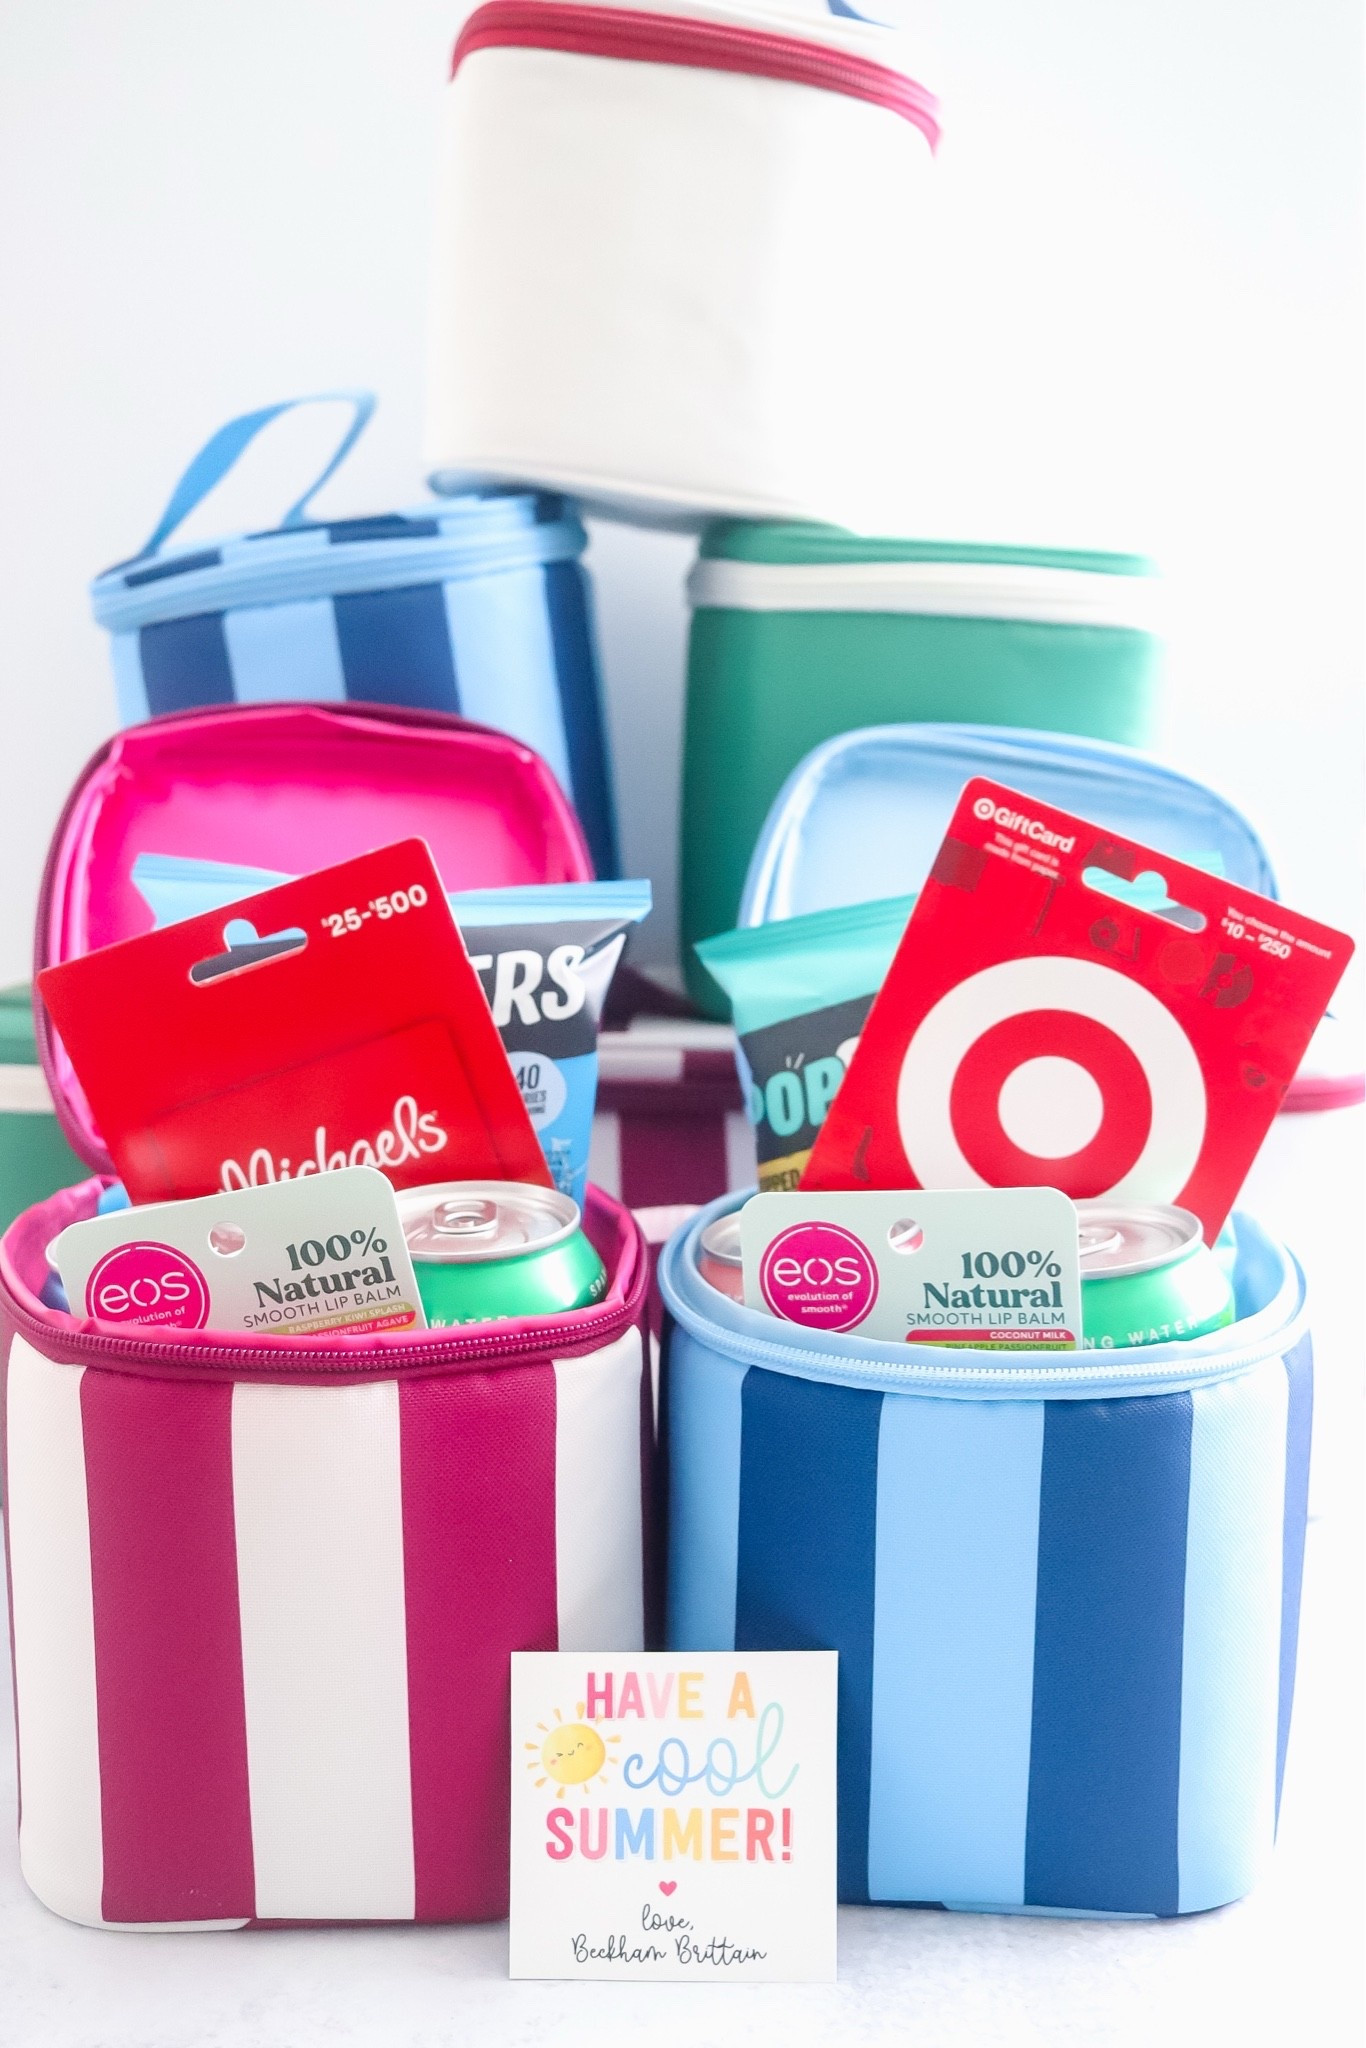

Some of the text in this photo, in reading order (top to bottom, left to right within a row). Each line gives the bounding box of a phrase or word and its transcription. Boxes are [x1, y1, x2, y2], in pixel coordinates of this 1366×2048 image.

[994, 807, 1075, 853] GiftCard
[286, 1227, 387, 1271] 100%
[961, 1250, 1062, 1279] 100%
[253, 1256, 396, 1308] Natural
[773, 1257, 862, 1286] eos
[100, 1272, 190, 1313] eos
[244, 1285, 401, 1328] SMOOTH LIP BALM
[787, 1291, 853, 1301] evolution of
[923, 1281, 1063, 1309] Natural
[288, 1304, 406, 1334] RASPBERRY KIWI SPLASH
[376, 1315, 409, 1329] AGAVE
[906, 1313, 1065, 1325] SMOOTH LIP BALM
[990, 1331, 1066, 1339] COCONUT MILK
[586, 1672, 756, 1720] HAVE A
[623, 1702, 800, 1800] cool
[546, 1807, 792, 1862] SUMMER!
[642, 1904, 694, 1932] love,
[572, 1933, 767, 1966] Beckham Brittain
